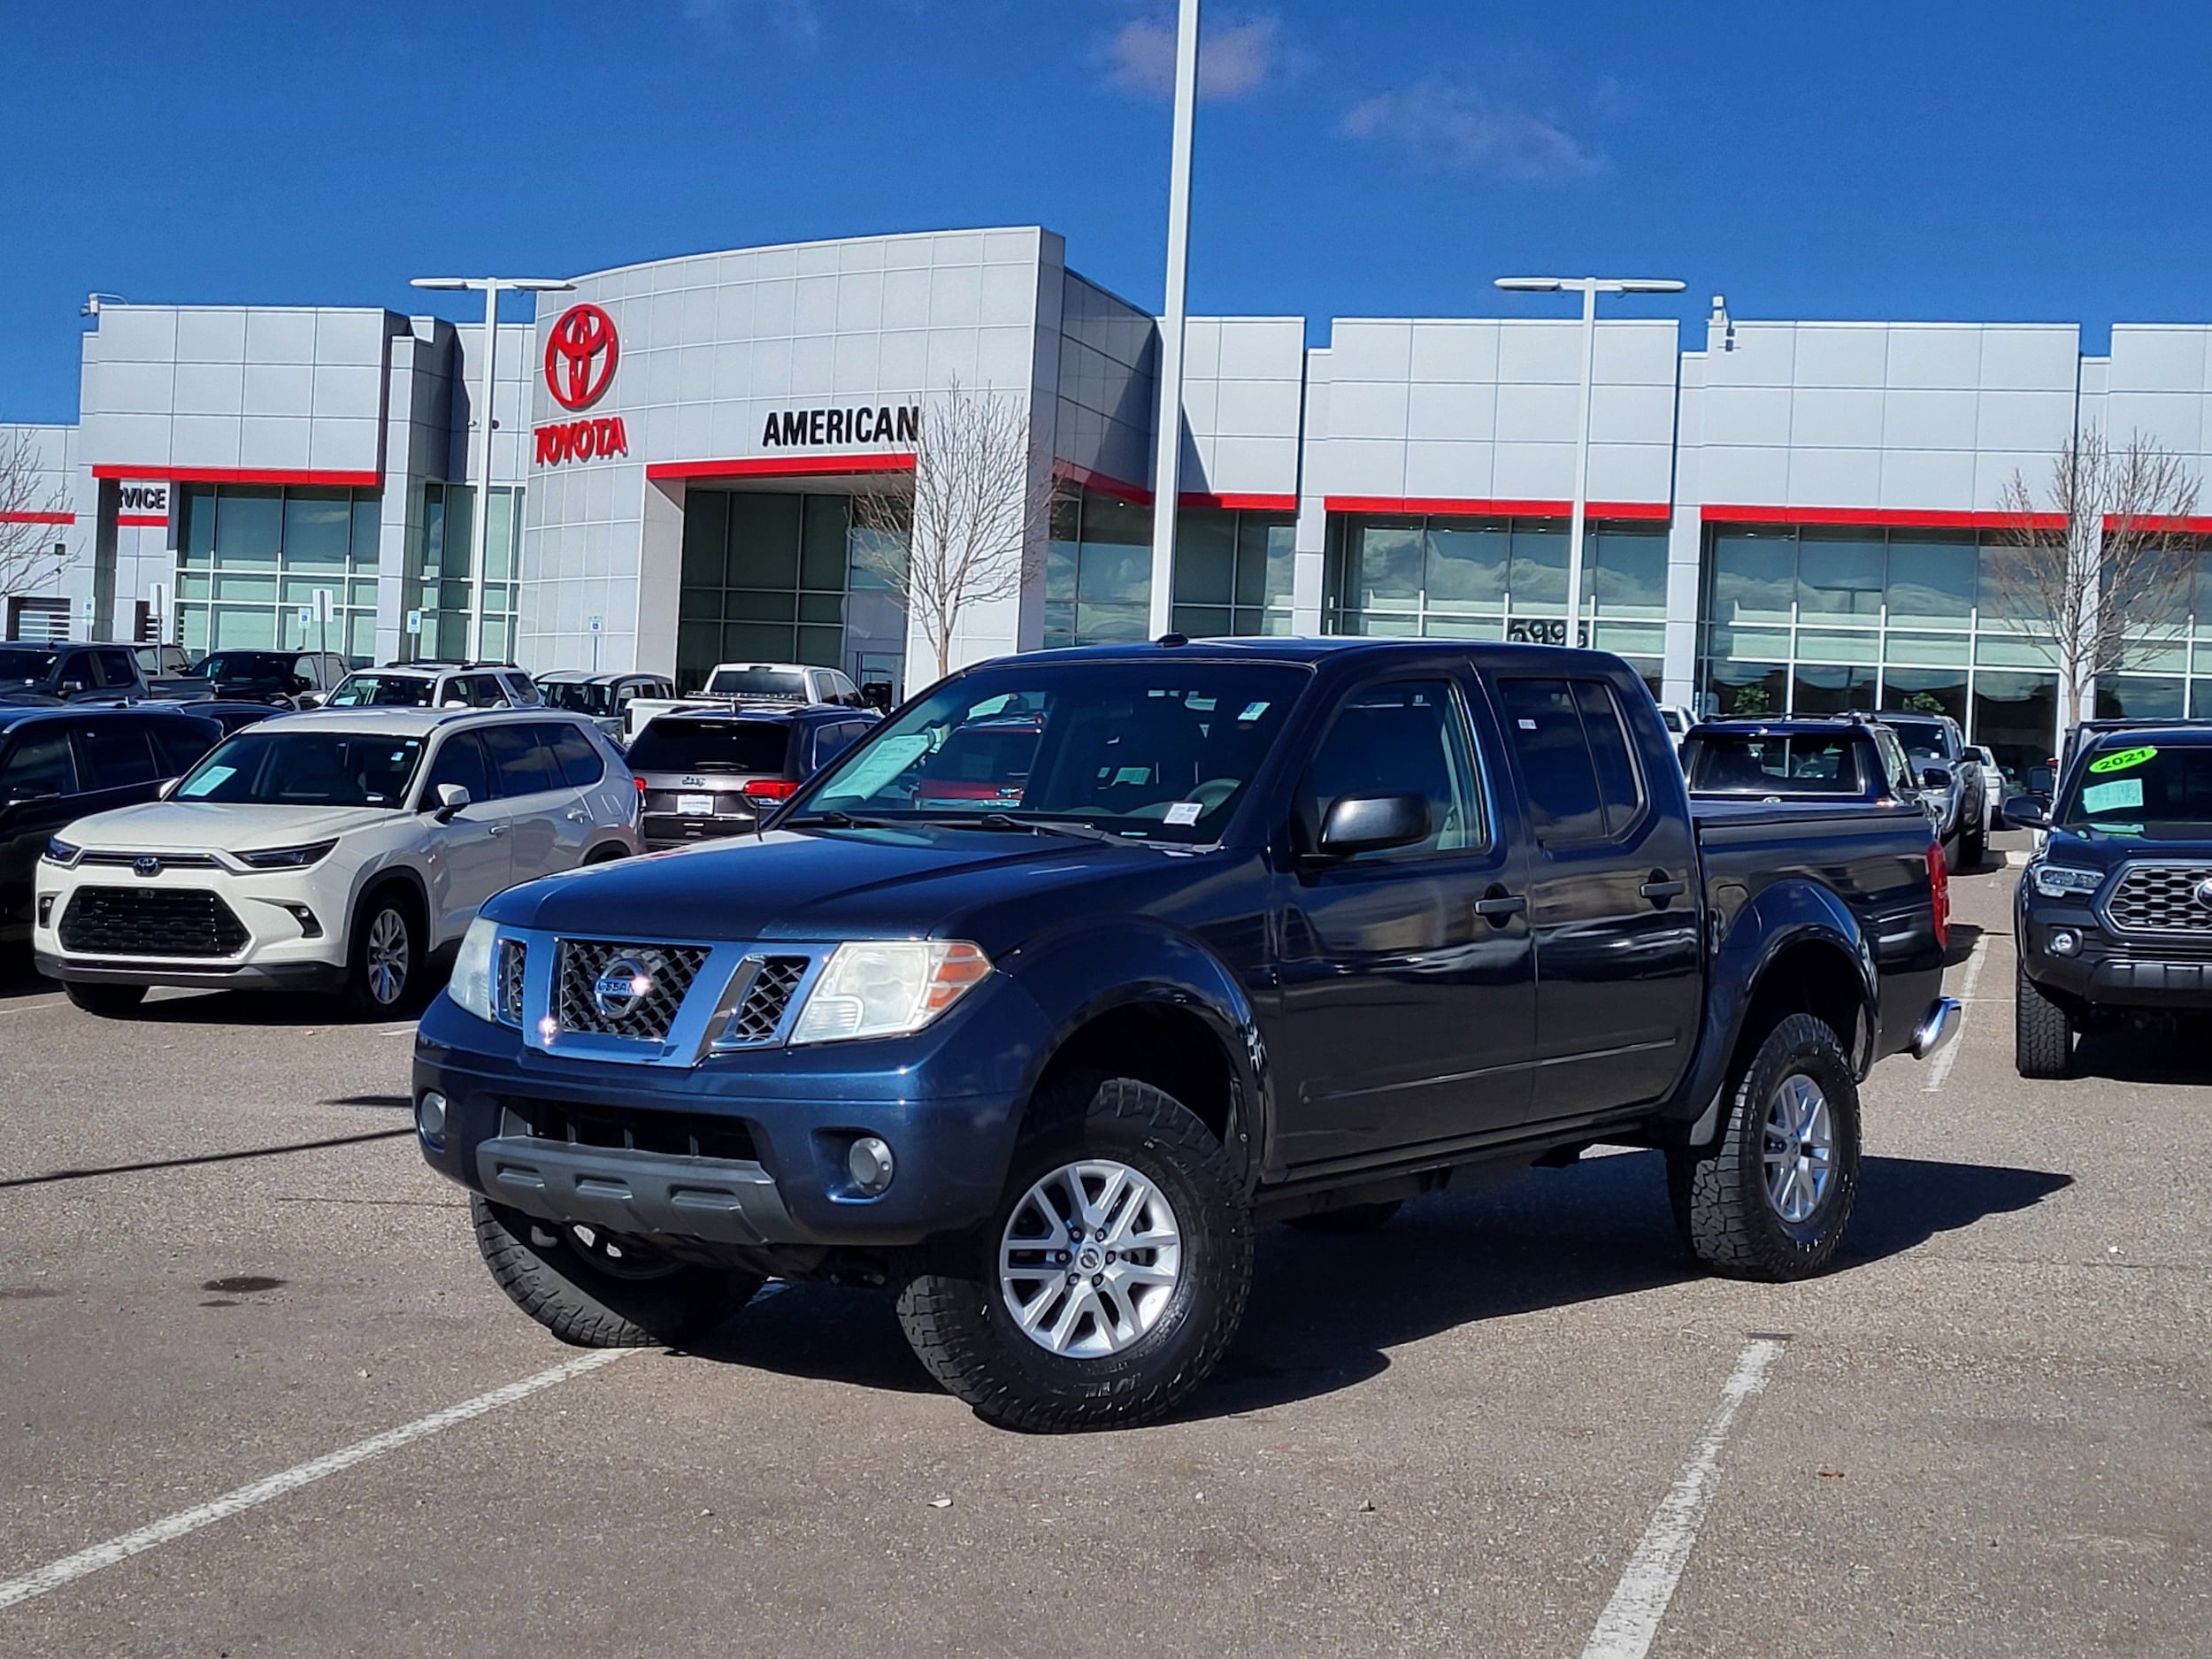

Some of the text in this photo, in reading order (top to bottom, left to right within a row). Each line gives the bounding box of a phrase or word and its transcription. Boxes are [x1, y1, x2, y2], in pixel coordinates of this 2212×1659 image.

[534, 417, 626, 465] TOYOTA
[762, 406, 918, 446] AMERICAN
[2099, 750, 2147, 771] 2021
